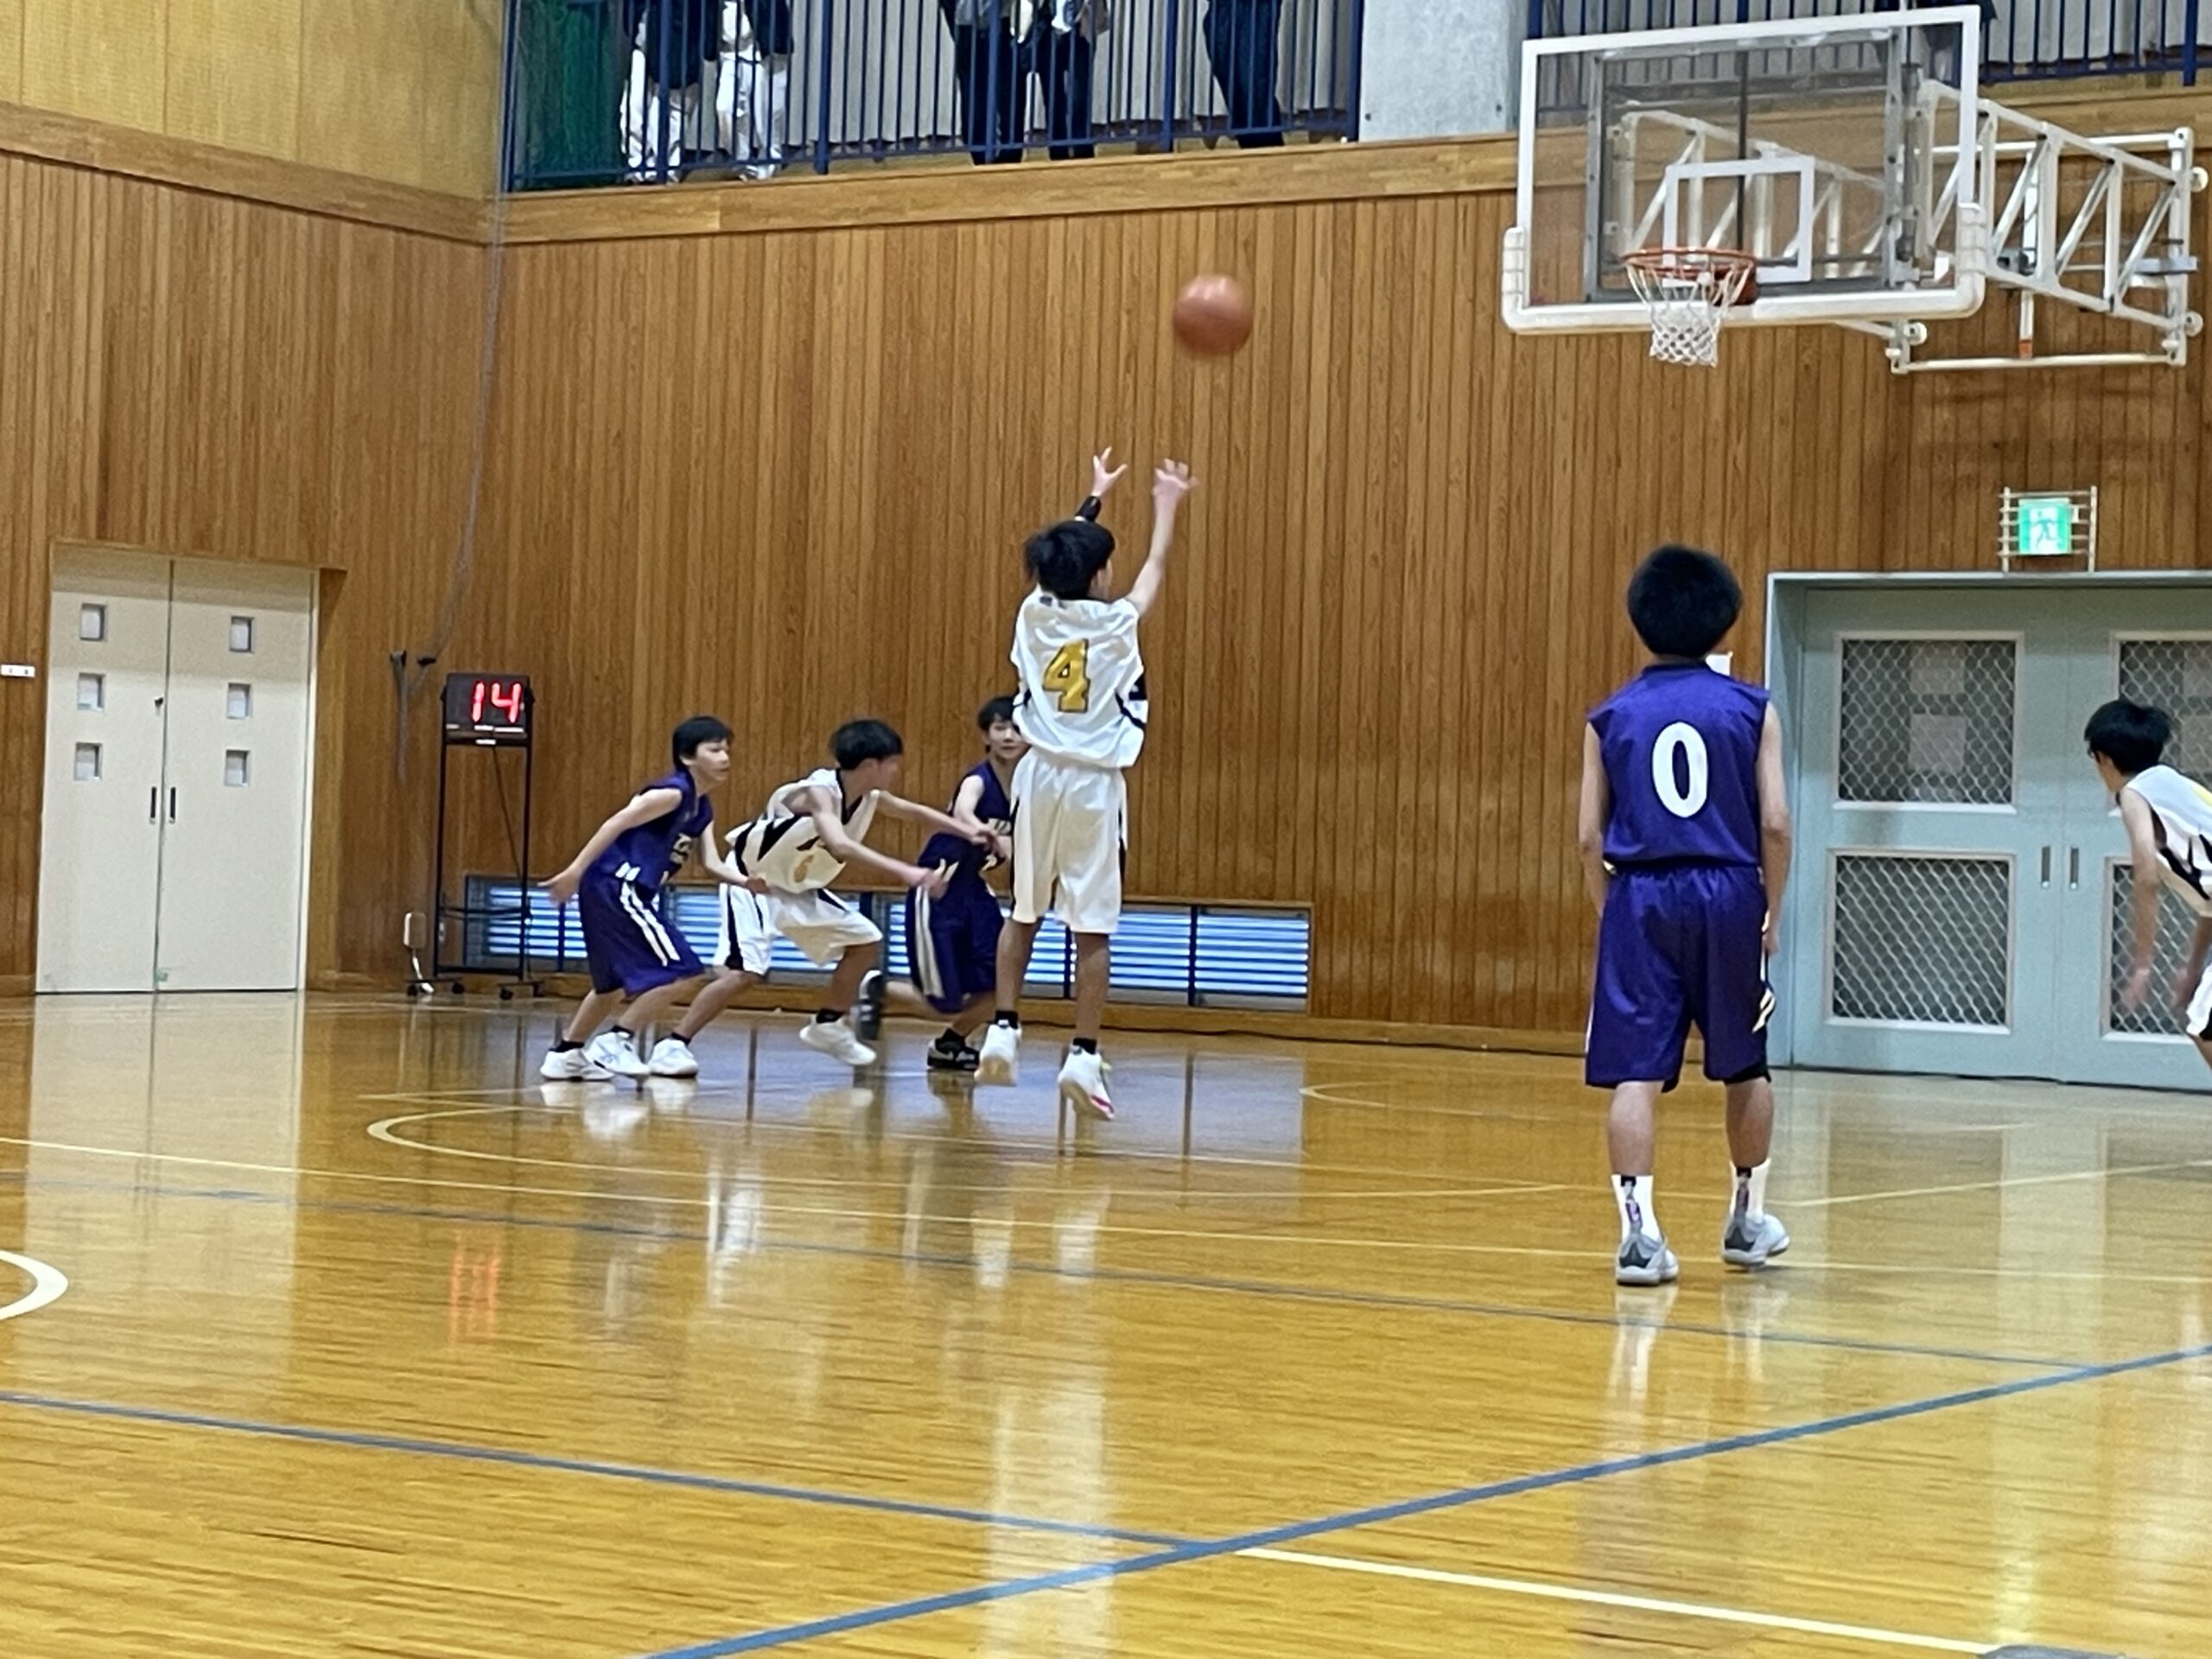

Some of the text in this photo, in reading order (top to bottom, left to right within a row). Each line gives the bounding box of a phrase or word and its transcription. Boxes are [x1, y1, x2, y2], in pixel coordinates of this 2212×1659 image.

[472, 680, 522, 723] 14
[1042, 638, 1090, 714] 4
[1652, 721, 1708, 818] 0
